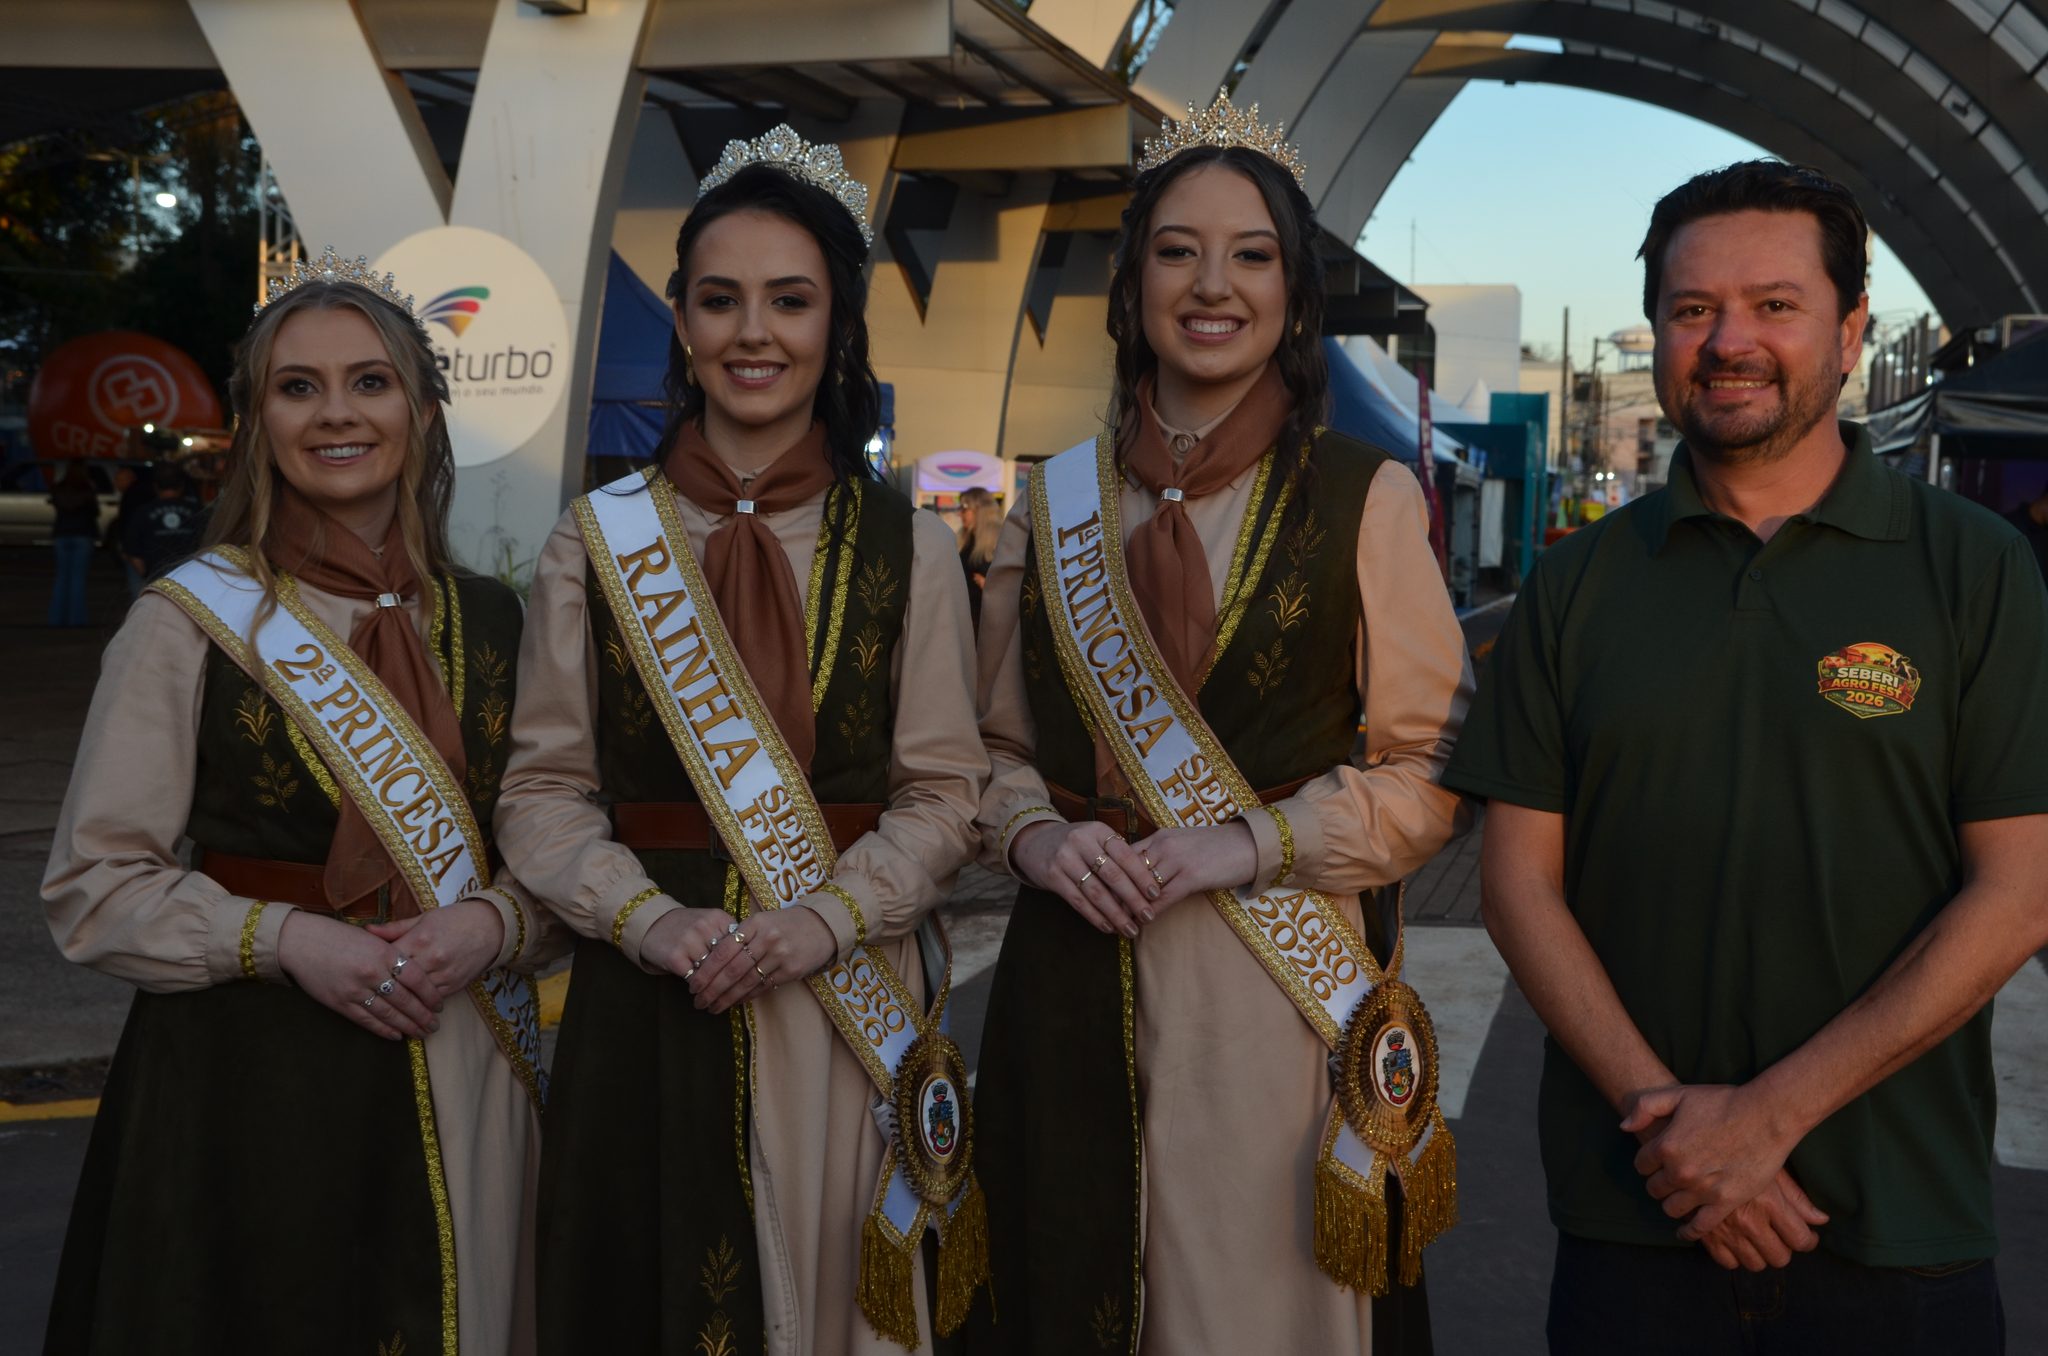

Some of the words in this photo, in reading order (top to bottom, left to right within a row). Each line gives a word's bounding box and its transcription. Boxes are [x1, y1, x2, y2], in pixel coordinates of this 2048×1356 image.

[616, 534, 761, 790] RAINHA
[1060, 539, 1174, 759] PRINCESA
[1831, 678, 1869, 690] AGRO
[1871, 681, 1902, 699] FEST
[1837, 667, 1899, 688] SEBERI
[1845, 690, 1885, 708] 2026
[310, 679, 465, 887] PRINCESA
[1156, 767, 1213, 827] FE
[1248, 895, 1338, 1001] 2026
[1178, 754, 1240, 825] SEB
[1274, 890, 1357, 985] AGRO
[734, 797, 800, 902] FES
[828, 964, 889, 1047] 026
[758, 784, 829, 894] SEBE
[843, 956, 906, 1034] GRO
